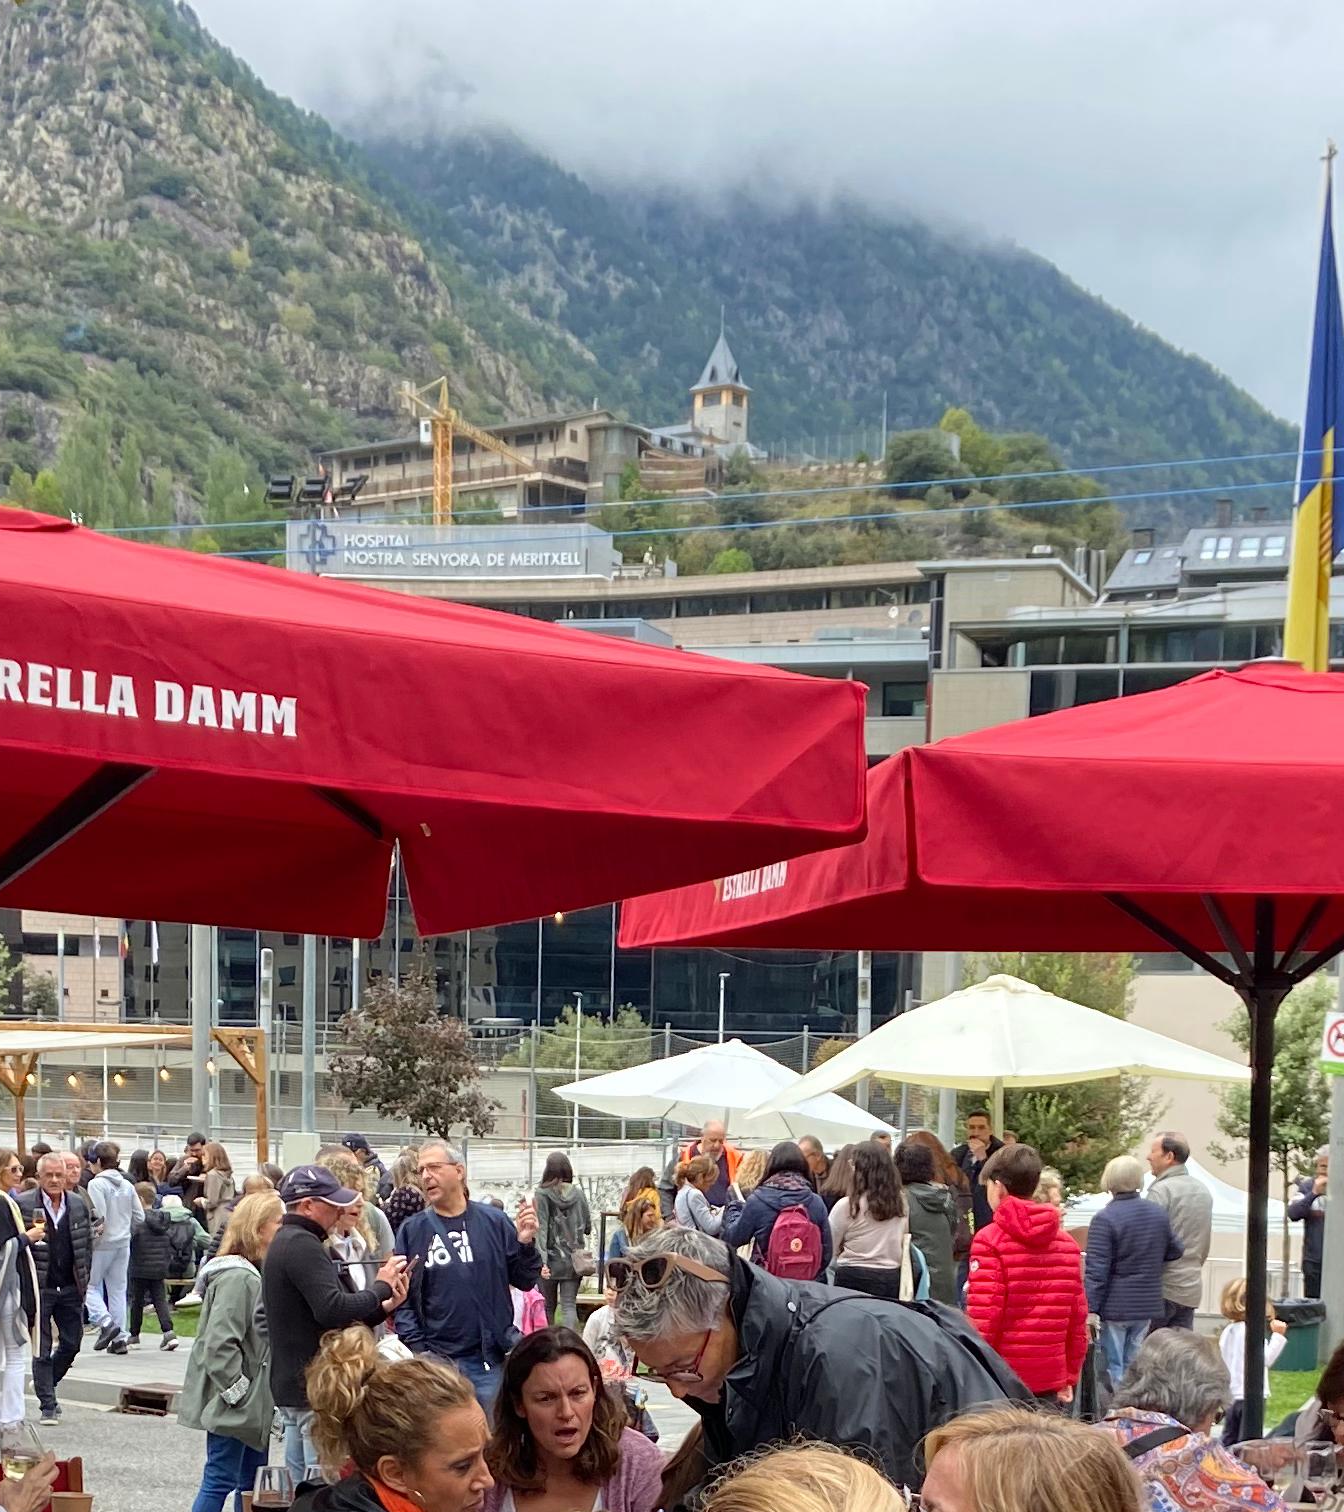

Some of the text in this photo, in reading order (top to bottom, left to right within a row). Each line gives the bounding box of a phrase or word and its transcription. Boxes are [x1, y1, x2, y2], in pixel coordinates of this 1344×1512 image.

[343, 533, 413, 548] HOSPITAL
[343, 550, 582, 567] NOSTRA SENYORA DE MERITXELL
[154, 680, 298, 738] DAMM
